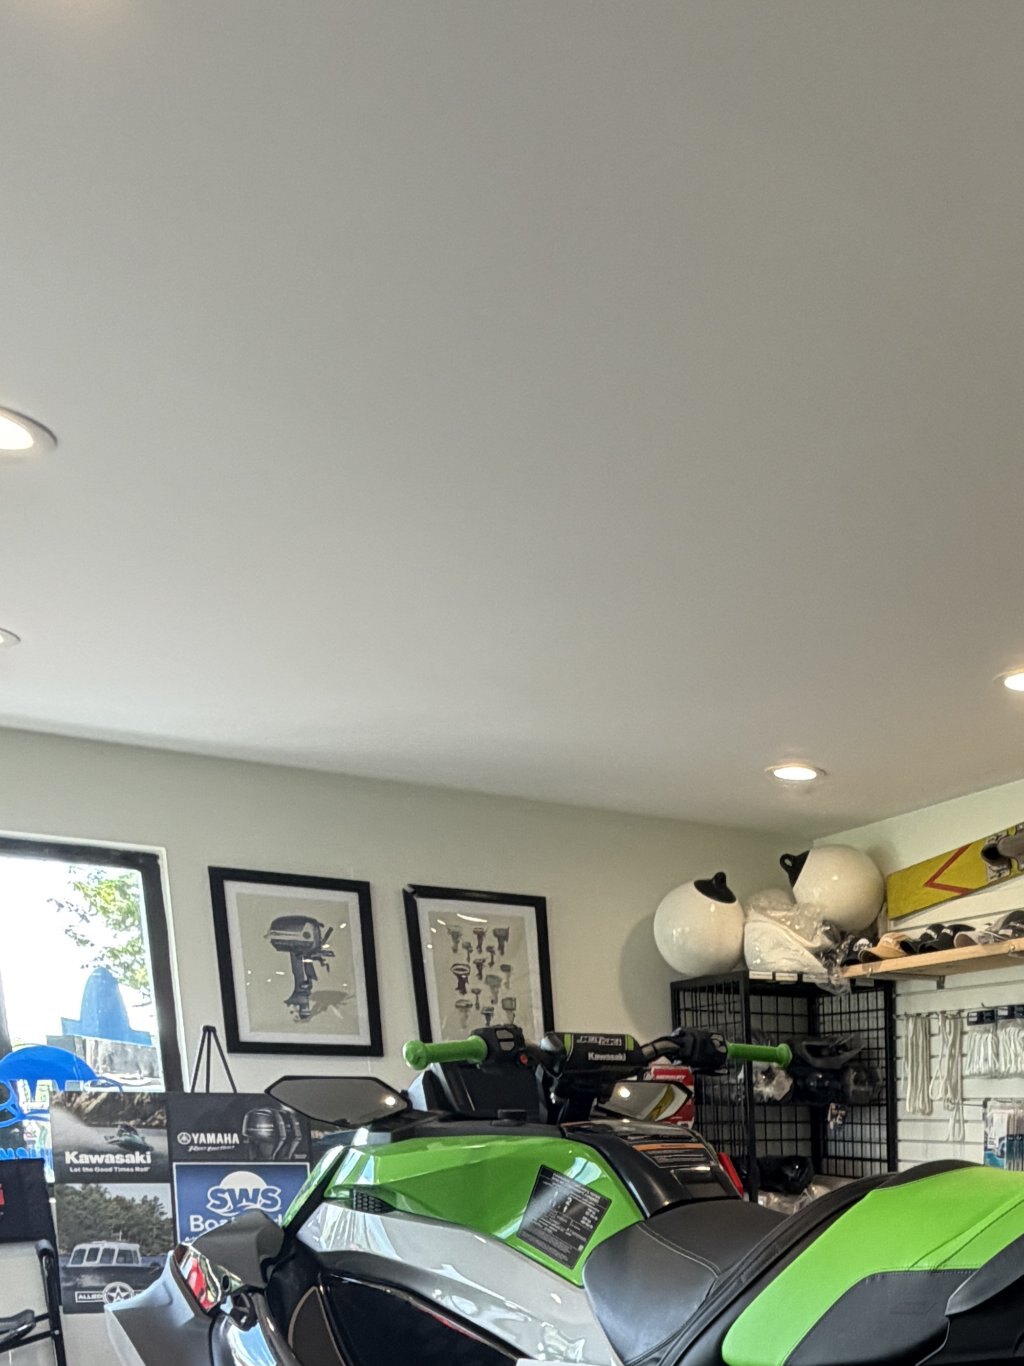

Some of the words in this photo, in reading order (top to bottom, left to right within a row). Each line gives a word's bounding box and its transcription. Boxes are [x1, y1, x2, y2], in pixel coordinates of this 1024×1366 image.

[192, 1133, 240, 1145] YAMAHA
[64, 1151, 152, 1164] Kawasaki
[206, 1185, 282, 1214] SWS
